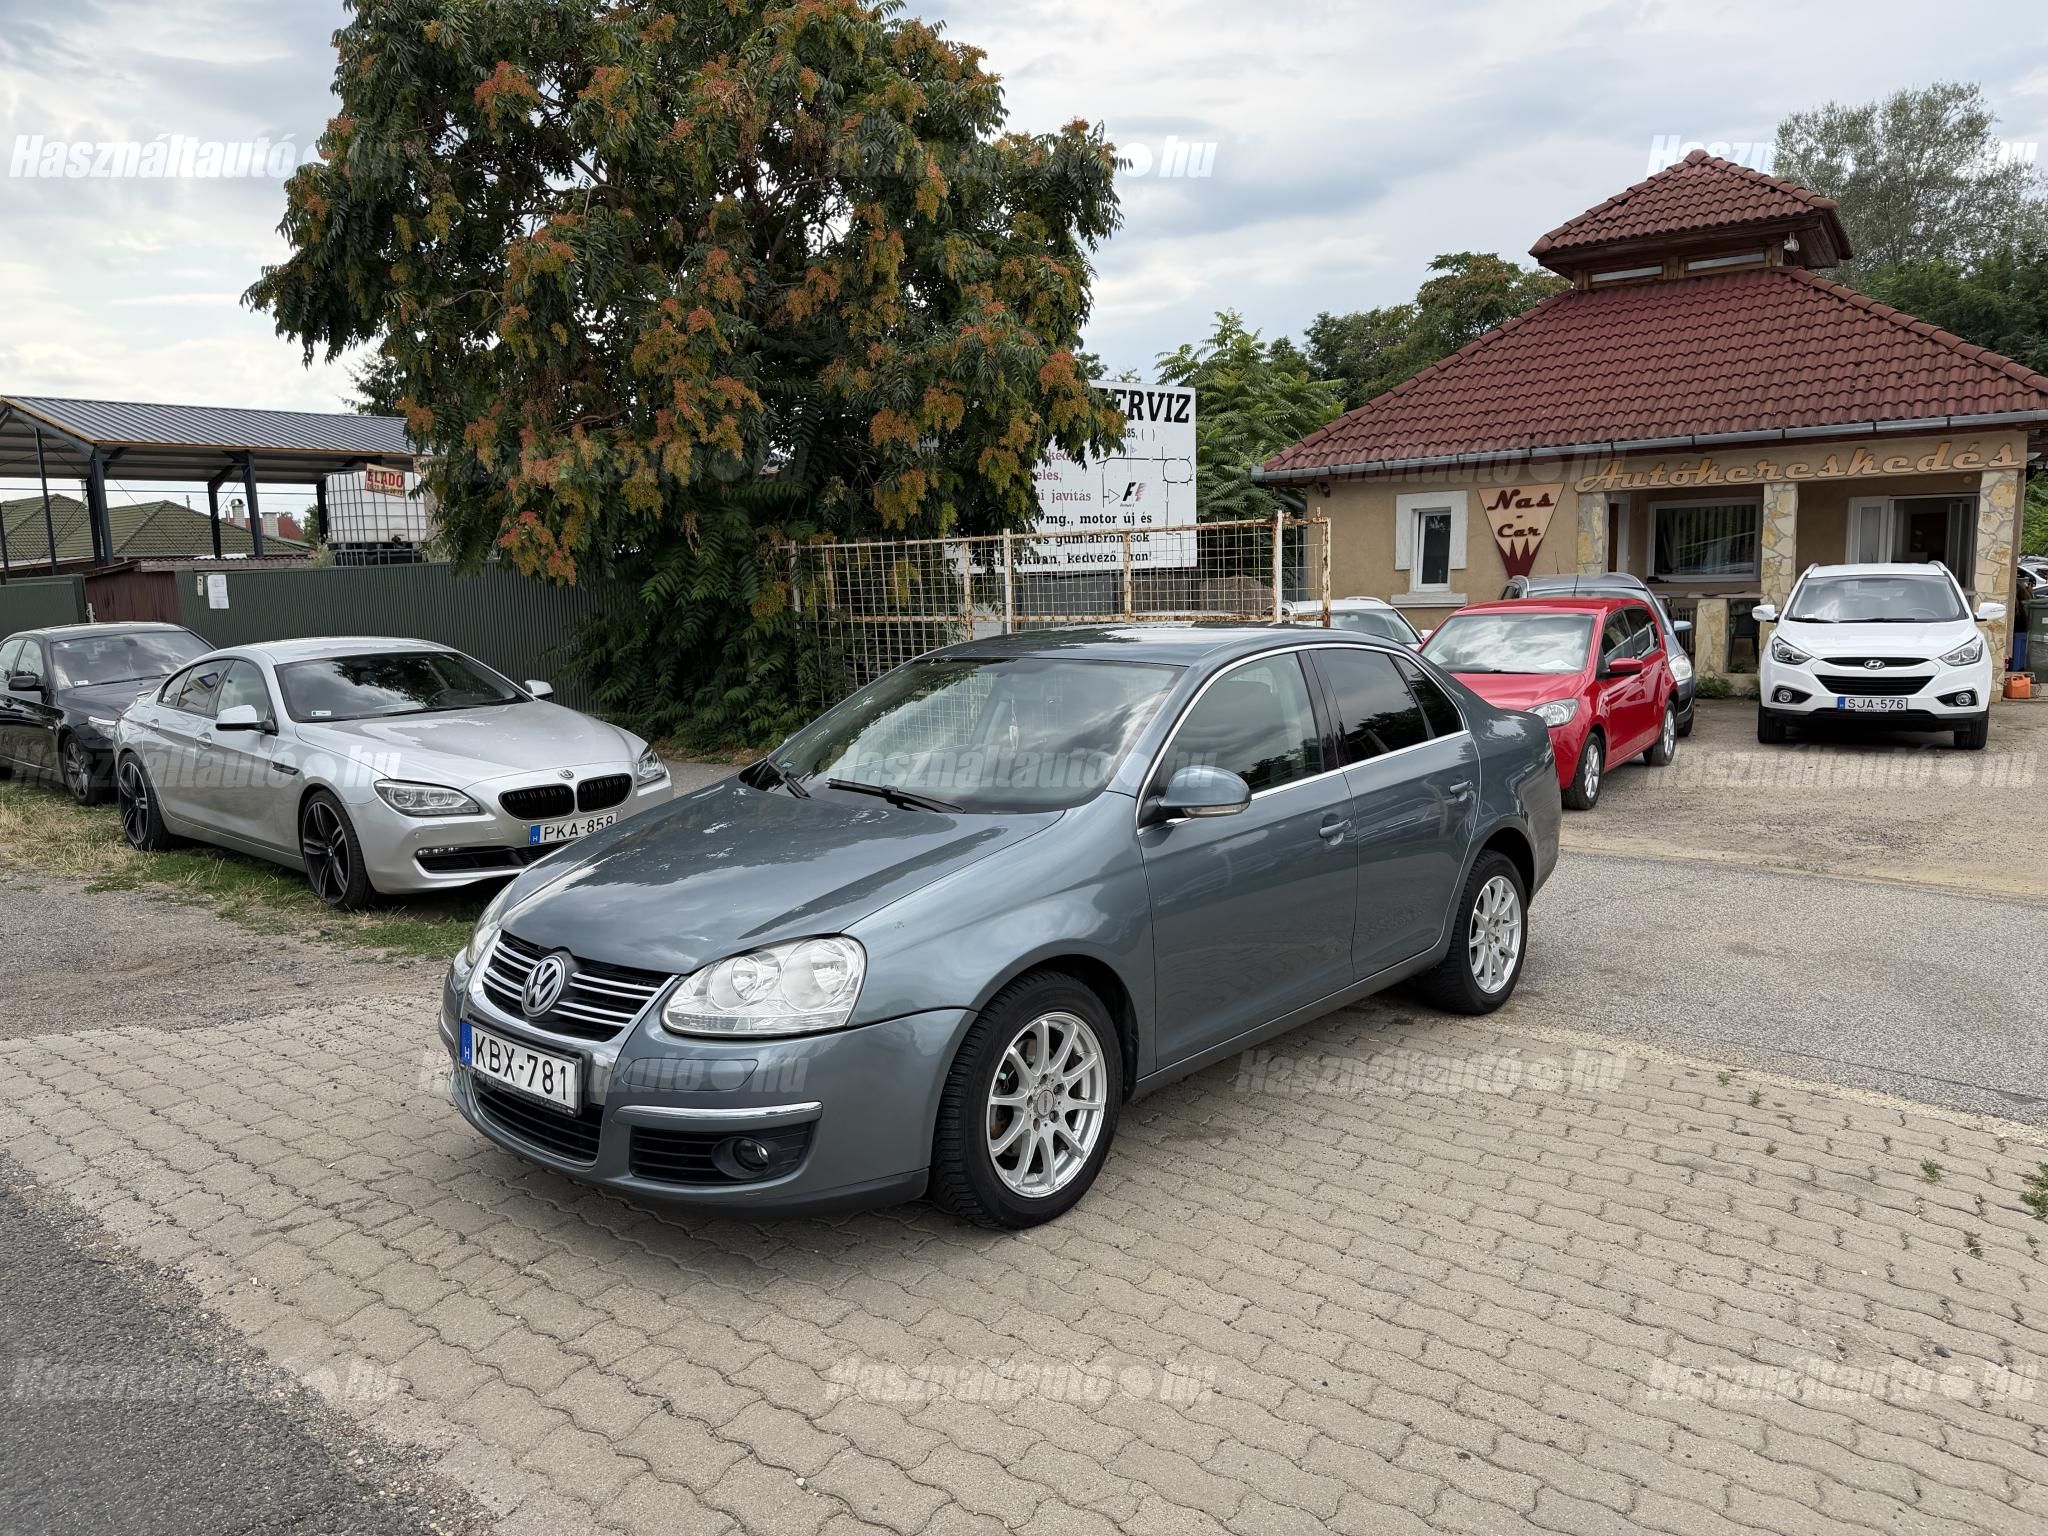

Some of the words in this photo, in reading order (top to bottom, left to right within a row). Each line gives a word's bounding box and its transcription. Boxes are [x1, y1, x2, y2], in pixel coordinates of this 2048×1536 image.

[1575, 440, 2023, 492] Autókereskedés
[1051, 488, 1092, 504] javítás
[1486, 488, 1555, 511] Nas
[1080, 513, 1117, 524] motor
[1123, 512, 1135, 526] új
[1140, 511, 1153, 524] és
[1497, 523, 1541, 538] Car
[1066, 550, 1117, 564] kedvező
[1847, 698, 1904, 710] SJA-576
[475, 1032, 566, 1100] KBX-781
